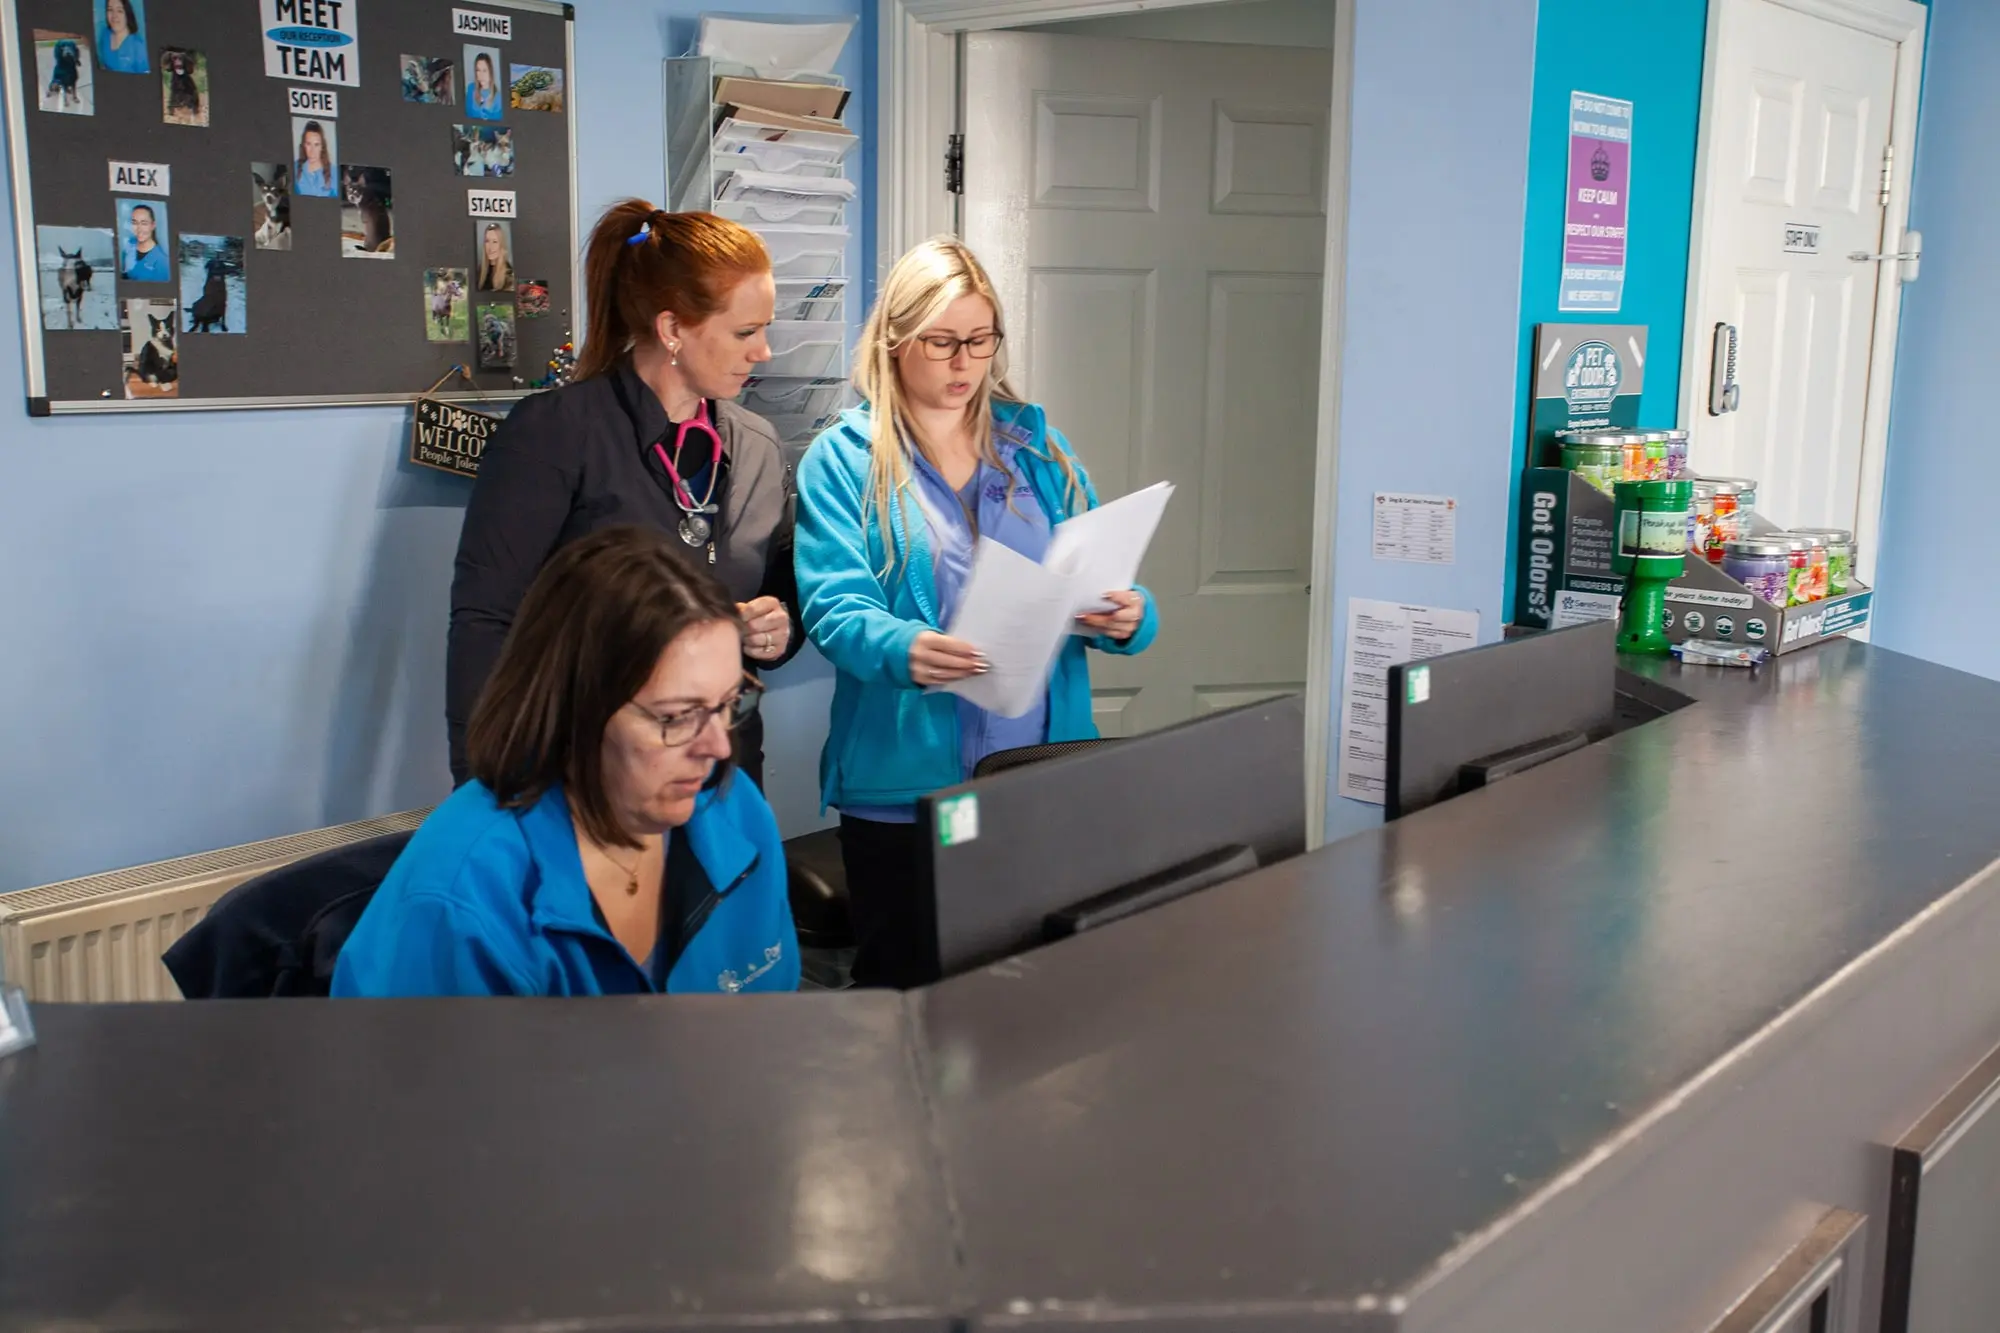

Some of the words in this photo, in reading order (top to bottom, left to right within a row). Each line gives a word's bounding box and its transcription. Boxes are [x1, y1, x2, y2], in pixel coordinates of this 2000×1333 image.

[275, 0, 342, 30] MEET
[457, 14, 509, 35] JASMINE
[276, 45, 346, 81] TEAM
[291, 91, 333, 111] SOFIE
[116, 166, 158, 187] ALEX
[471, 197, 513, 213] STACEY
[1586, 347, 1605, 366] PET
[1580, 366, 1605, 386] ODOR
[420, 446, 453, 465] People
[1531, 492, 1557, 534] Got
[1572, 515, 1603, 527] Enzyme
[1571, 537, 1608, 548] Products
[1570, 547, 1598, 558] Attack
[1569, 558, 1598, 569] Smoke
[1527, 538, 1554, 620] Odors?
[1569, 579, 1612, 591] HUNDREDS
[1613, 584, 1625, 593] OF
